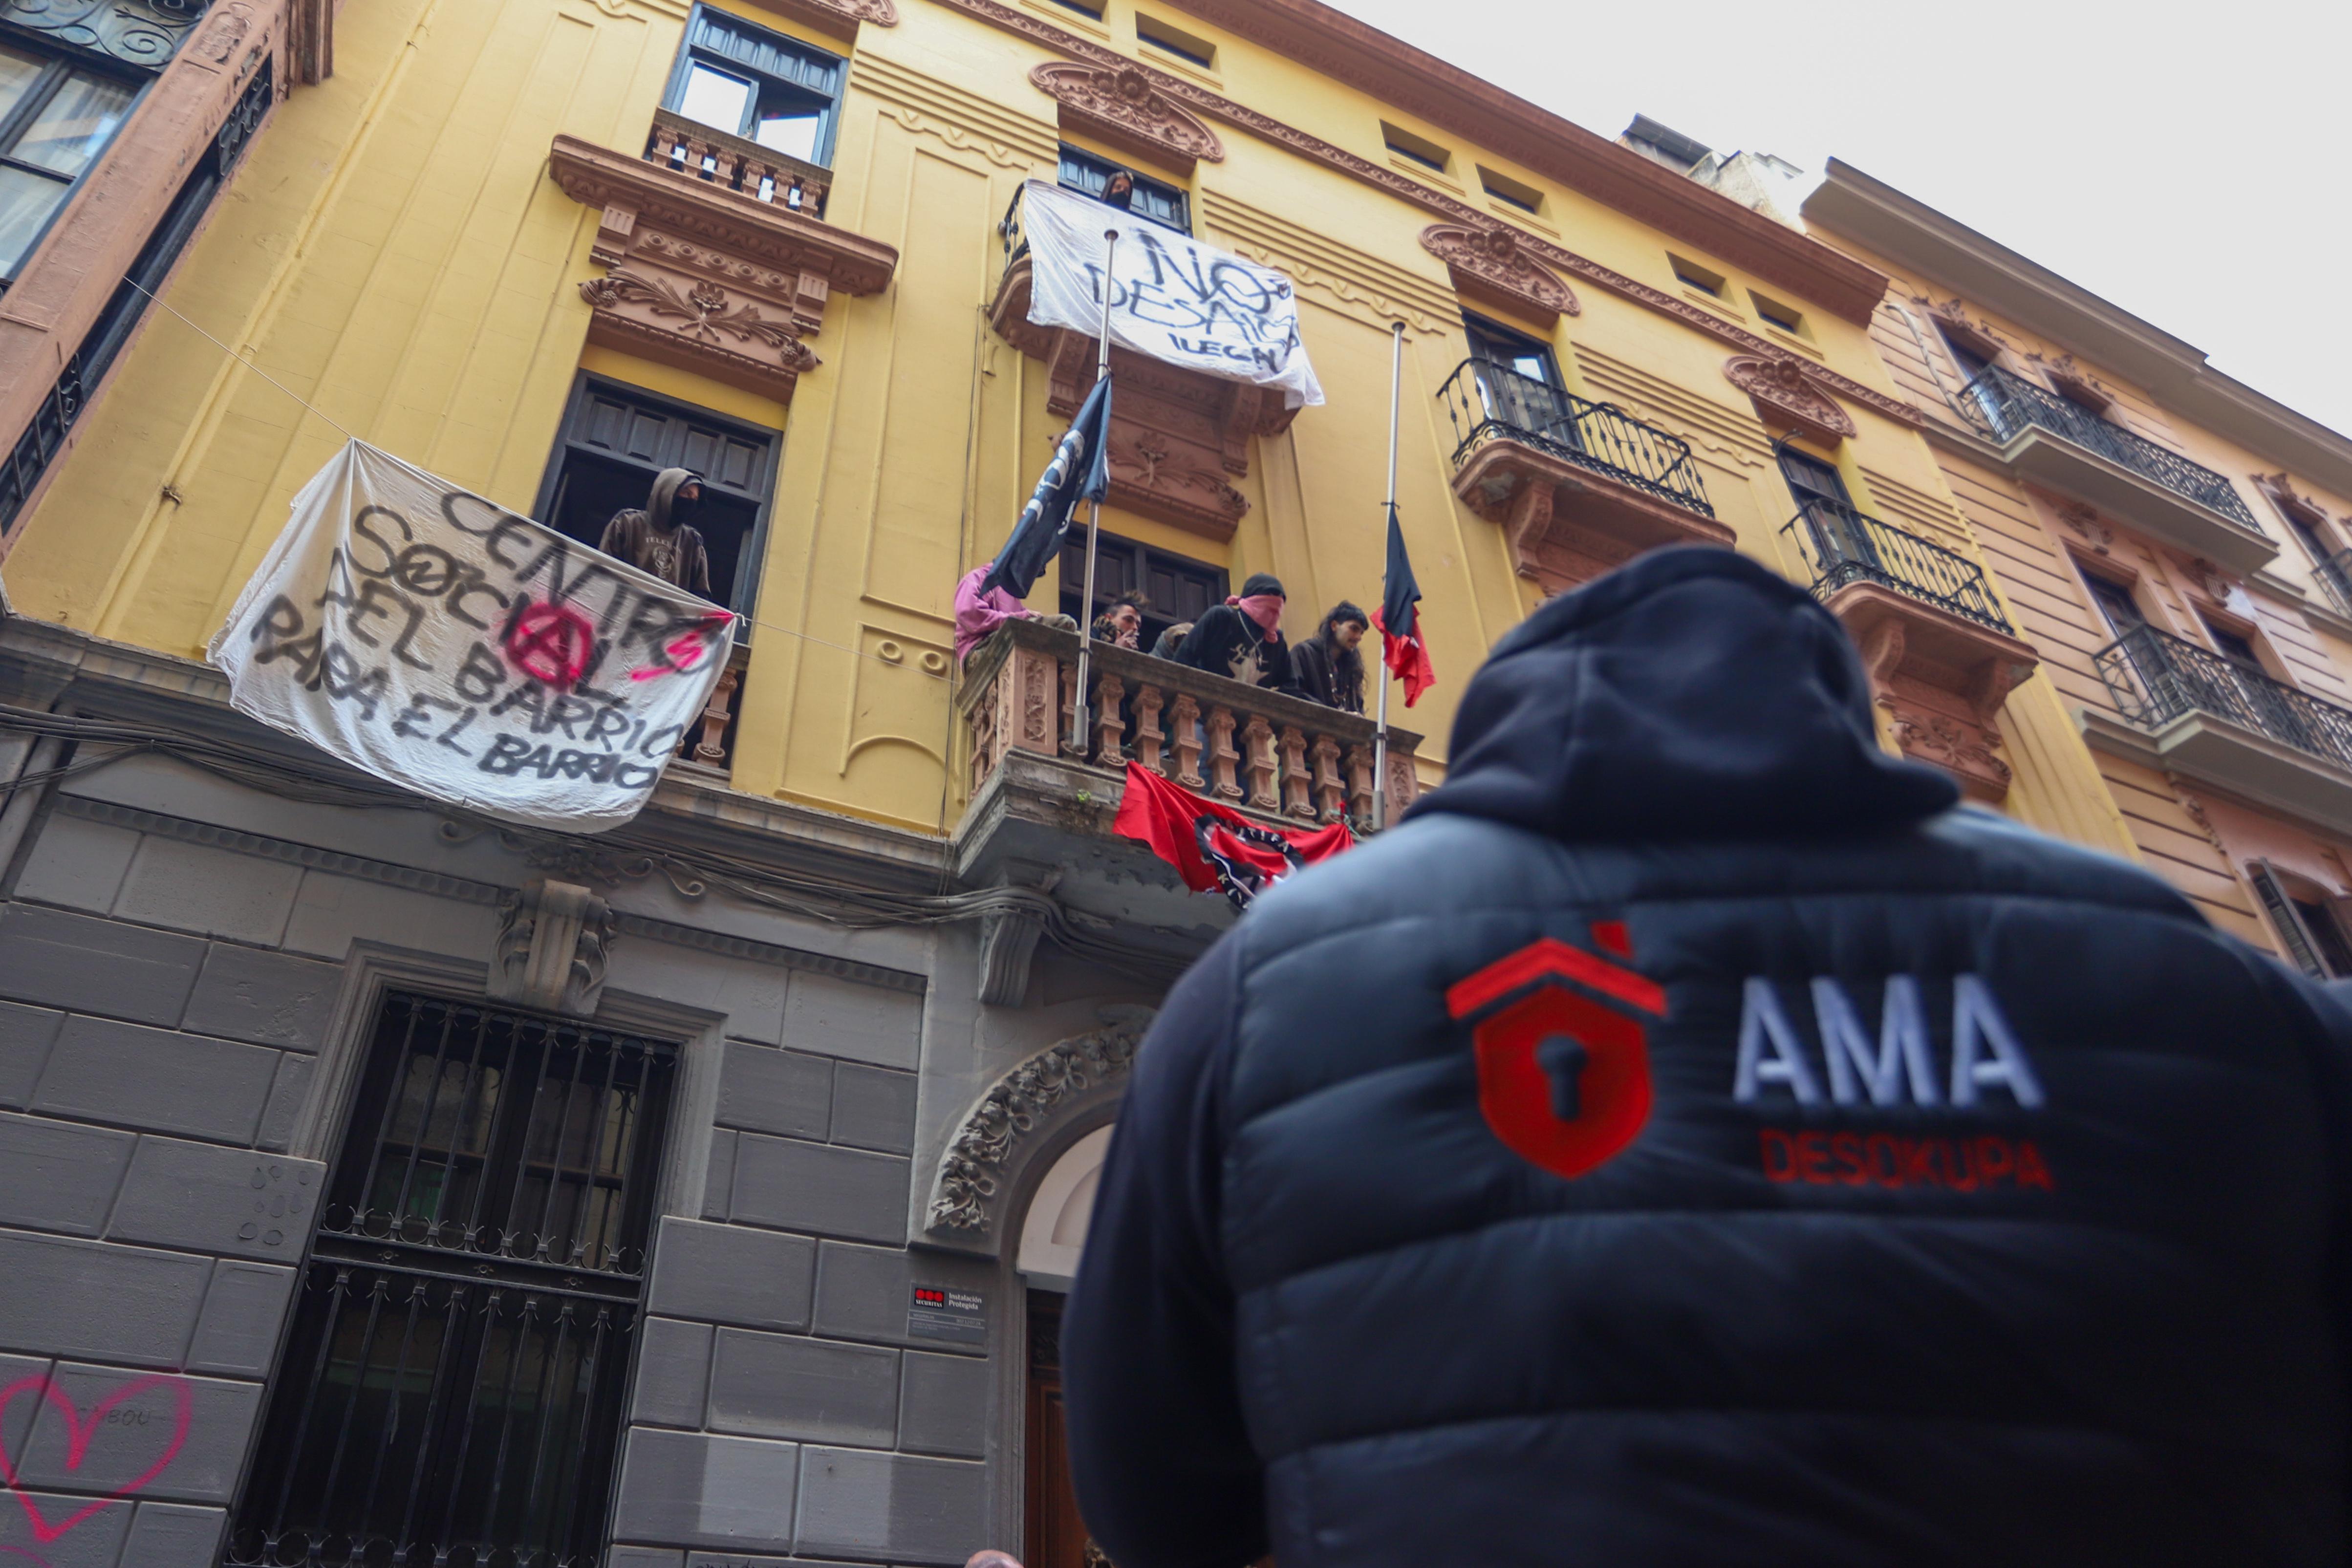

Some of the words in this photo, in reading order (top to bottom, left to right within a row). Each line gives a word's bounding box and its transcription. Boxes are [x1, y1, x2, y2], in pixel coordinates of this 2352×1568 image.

[1129, 228, 1271, 314] NO
[454, 641, 684, 759] BARRIO
[391, 692, 478, 757] EL
[476, 733, 658, 789] BARRIO
[1733, 973, 2045, 1109] AMA
[1759, 1128, 2054, 1192] DESOKUPA
[915, 1299, 943, 1308] SECURITAS
[949, 1292, 982, 1304] Instalación
[949, 1299, 978, 1310] Protegida
